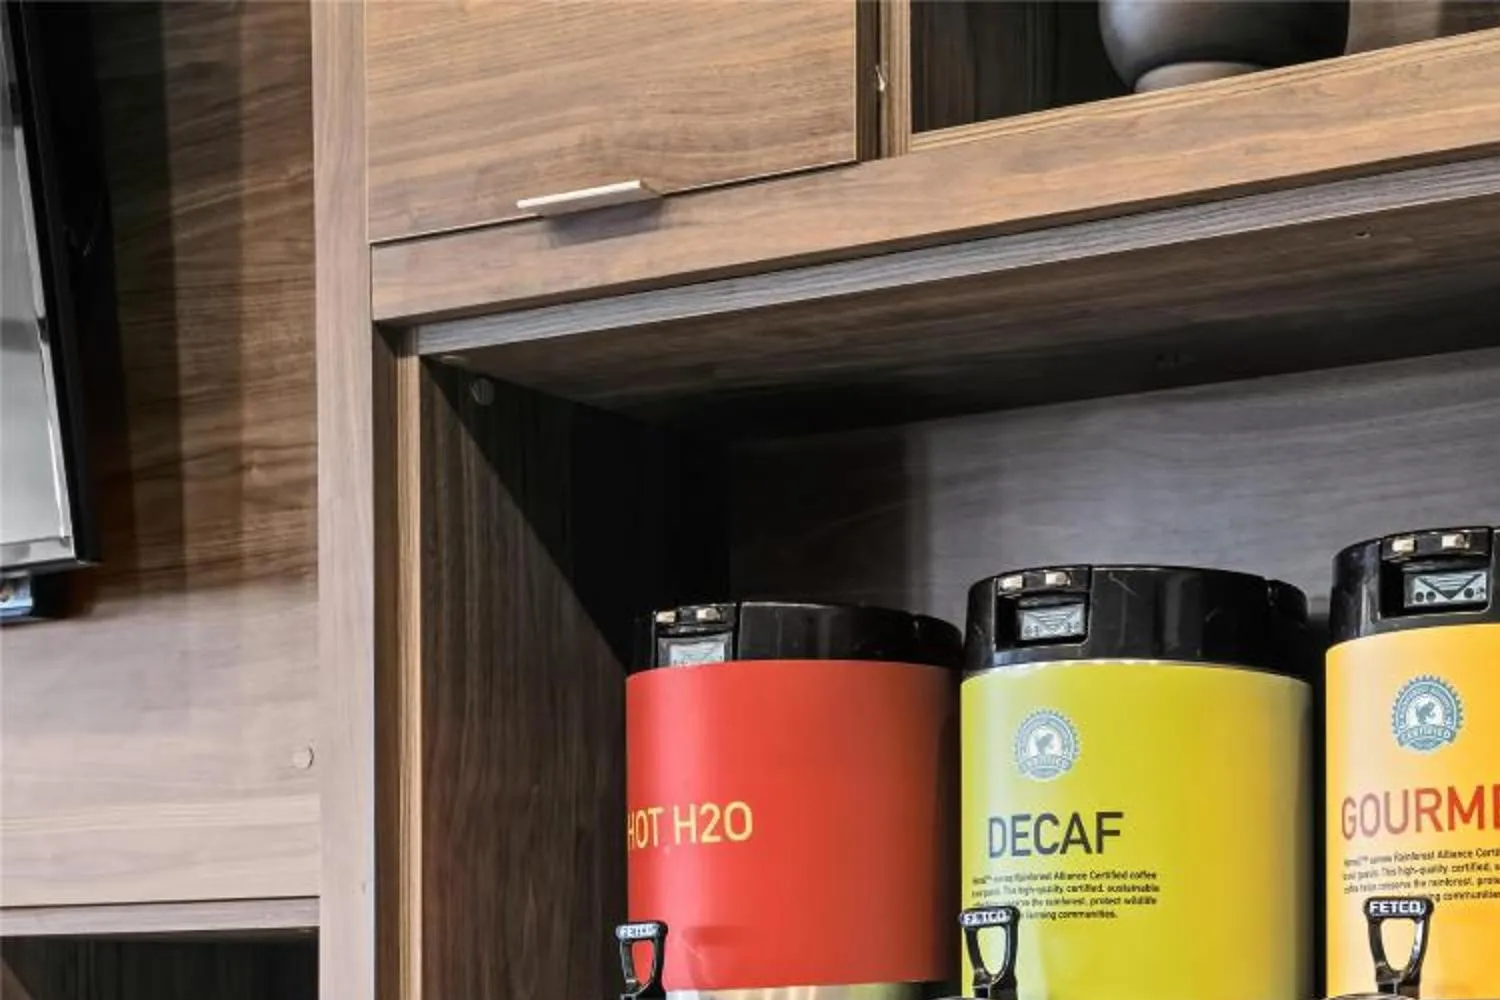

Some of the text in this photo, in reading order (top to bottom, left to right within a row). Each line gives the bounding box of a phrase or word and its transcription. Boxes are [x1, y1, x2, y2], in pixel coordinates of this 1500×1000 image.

[627, 800, 753, 850] HOT H2O
[988, 811, 1124, 858] DECAF
[1437, 849, 1473, 859] Alliance
[1054, 871, 1088, 880] Alliance
[1089, 869, 1128, 880] Certified
[1129, 869, 1157, 880] coffee
[1107, 883, 1160, 892] sustainable
[1090, 896, 1121, 907] protect
[1123, 896, 1157, 905] wildlife
[1369, 901, 1421, 914] FETCO
